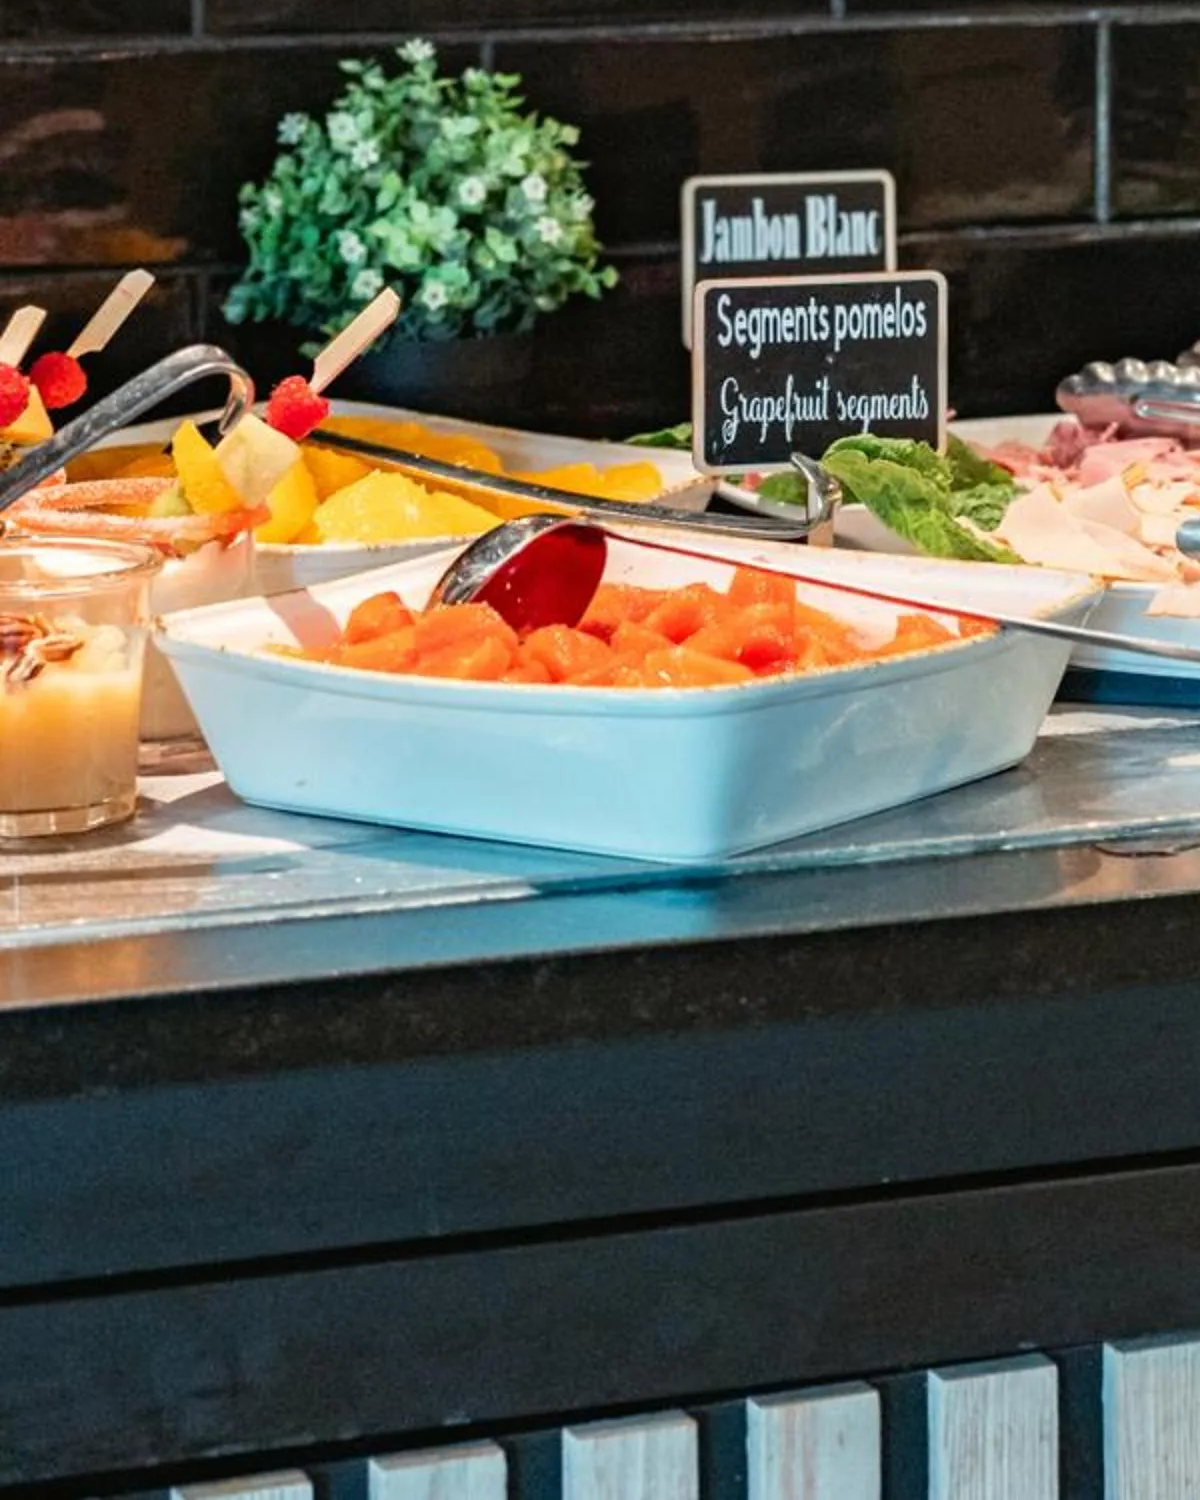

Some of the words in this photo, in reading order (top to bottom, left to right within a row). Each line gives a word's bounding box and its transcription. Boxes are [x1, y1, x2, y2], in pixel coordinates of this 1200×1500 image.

[701, 198, 800, 263] Jambon
[805, 195, 880, 258] Blanc
[717, 293, 829, 359] Segments
[834, 286, 926, 351] pomelos
[721, 374, 829, 444] Grapefruit
[836, 374, 929, 434] segments
